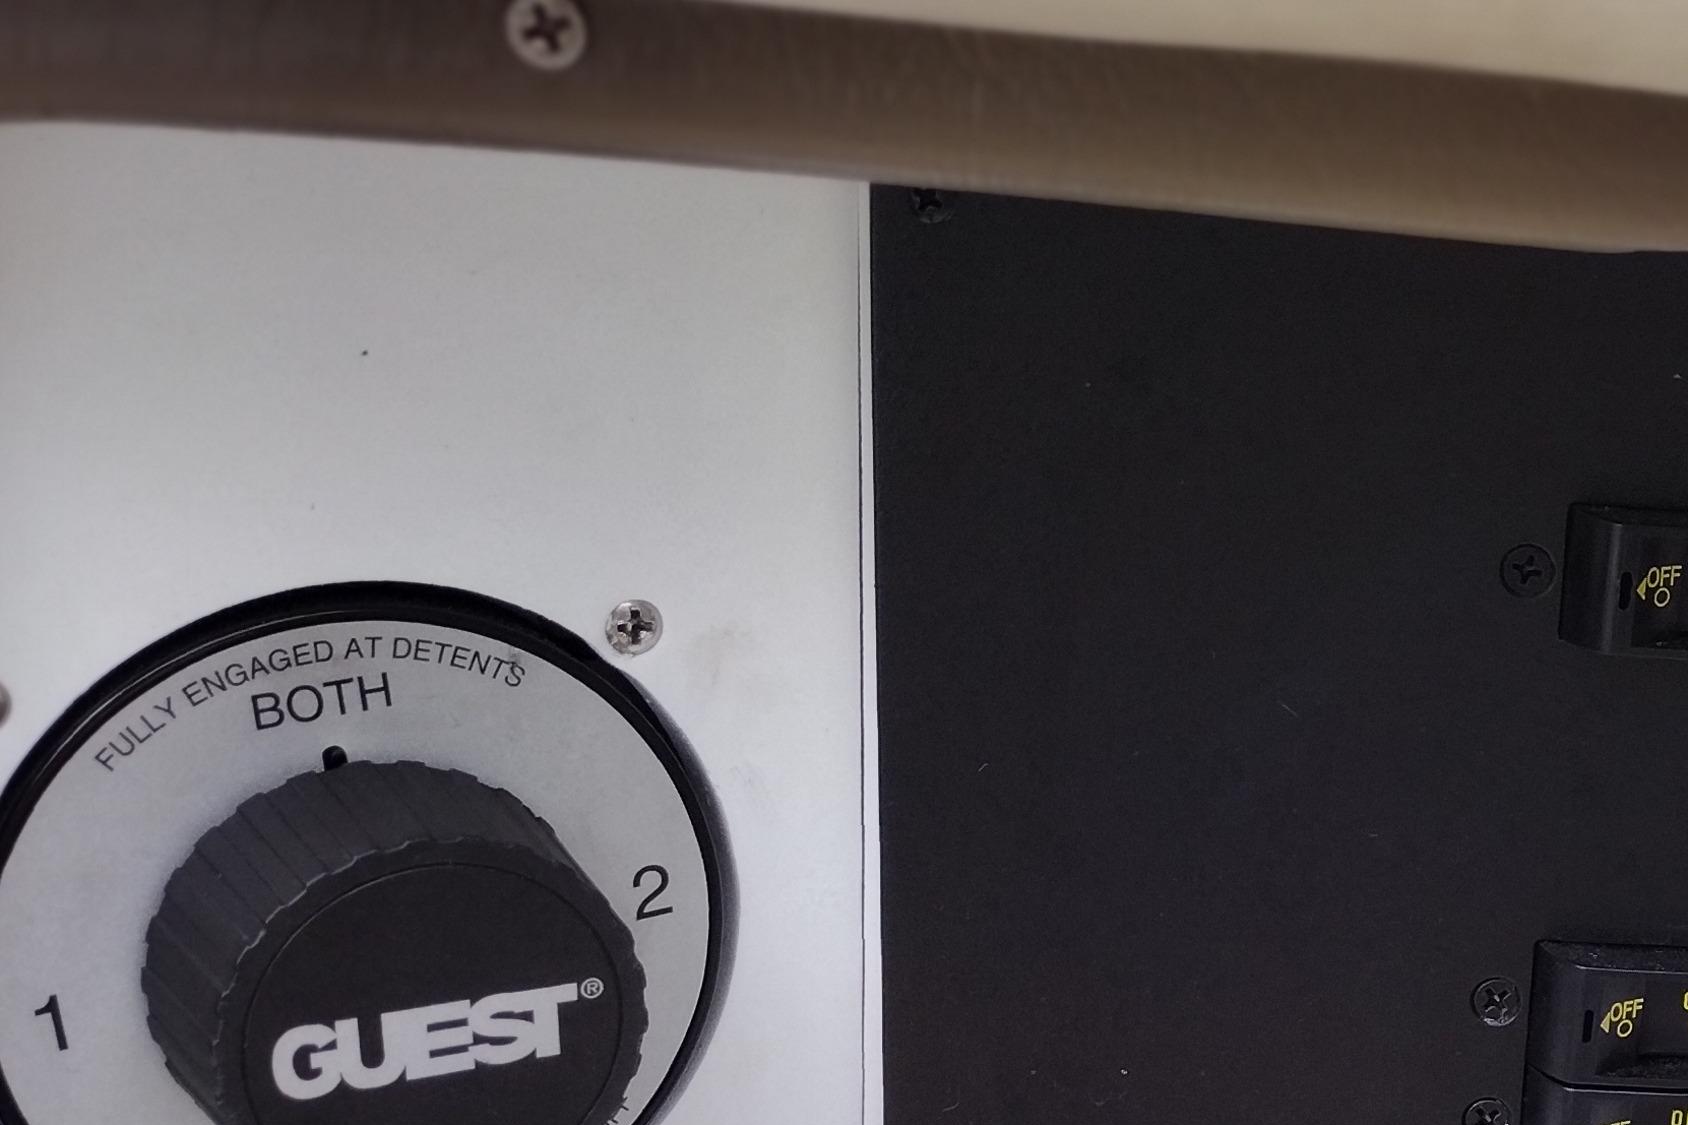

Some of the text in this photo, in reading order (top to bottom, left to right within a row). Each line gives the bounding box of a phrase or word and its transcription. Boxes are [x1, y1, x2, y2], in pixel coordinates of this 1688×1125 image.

[1646, 565, 1683, 588] OFF
[94, 636, 528, 772] FULLY ENGAGED AT DETENTS
[251, 672, 394, 731] BOTH
[631, 865, 674, 921] 2
[34, 994, 70, 1052] 1
[1609, 998, 1645, 1021] OFF
